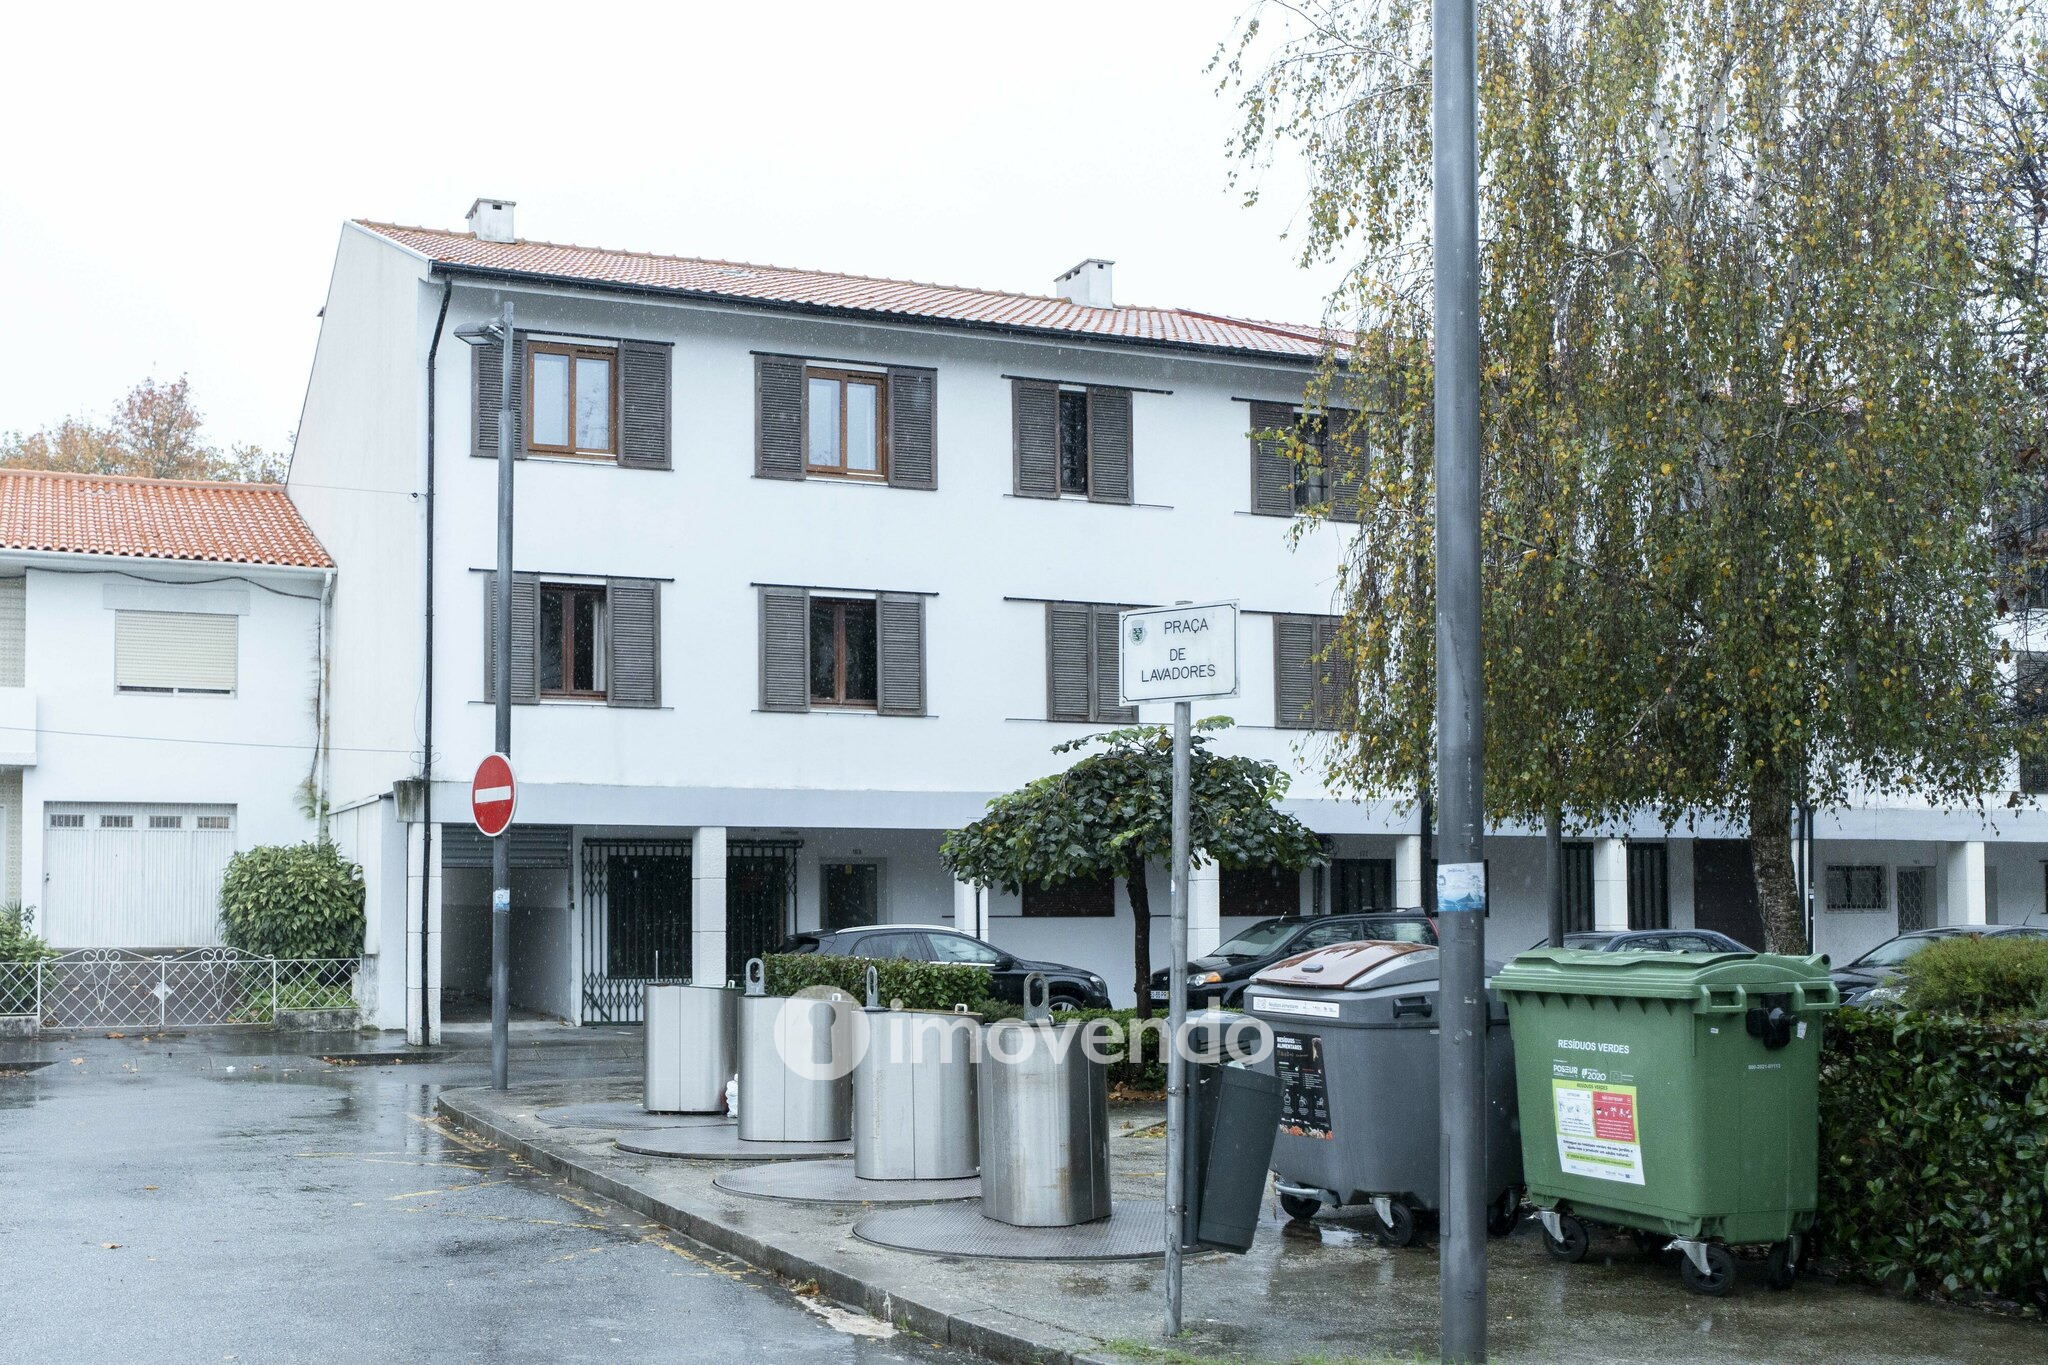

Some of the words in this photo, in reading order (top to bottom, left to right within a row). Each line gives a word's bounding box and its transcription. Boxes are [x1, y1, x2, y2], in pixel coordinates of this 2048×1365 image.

[1164, 618, 1208, 635] PRAÇA
[1169, 647, 1186, 661] DE
[1141, 664, 1216, 683] LAVADORES
[1558, 1039, 1596, 1051] RESÍDUOS
[1598, 1043, 1630, 1054] VERDES
[1553, 1064, 1578, 1074] POSEUR
[1587, 1071, 1606, 1081] 2020
